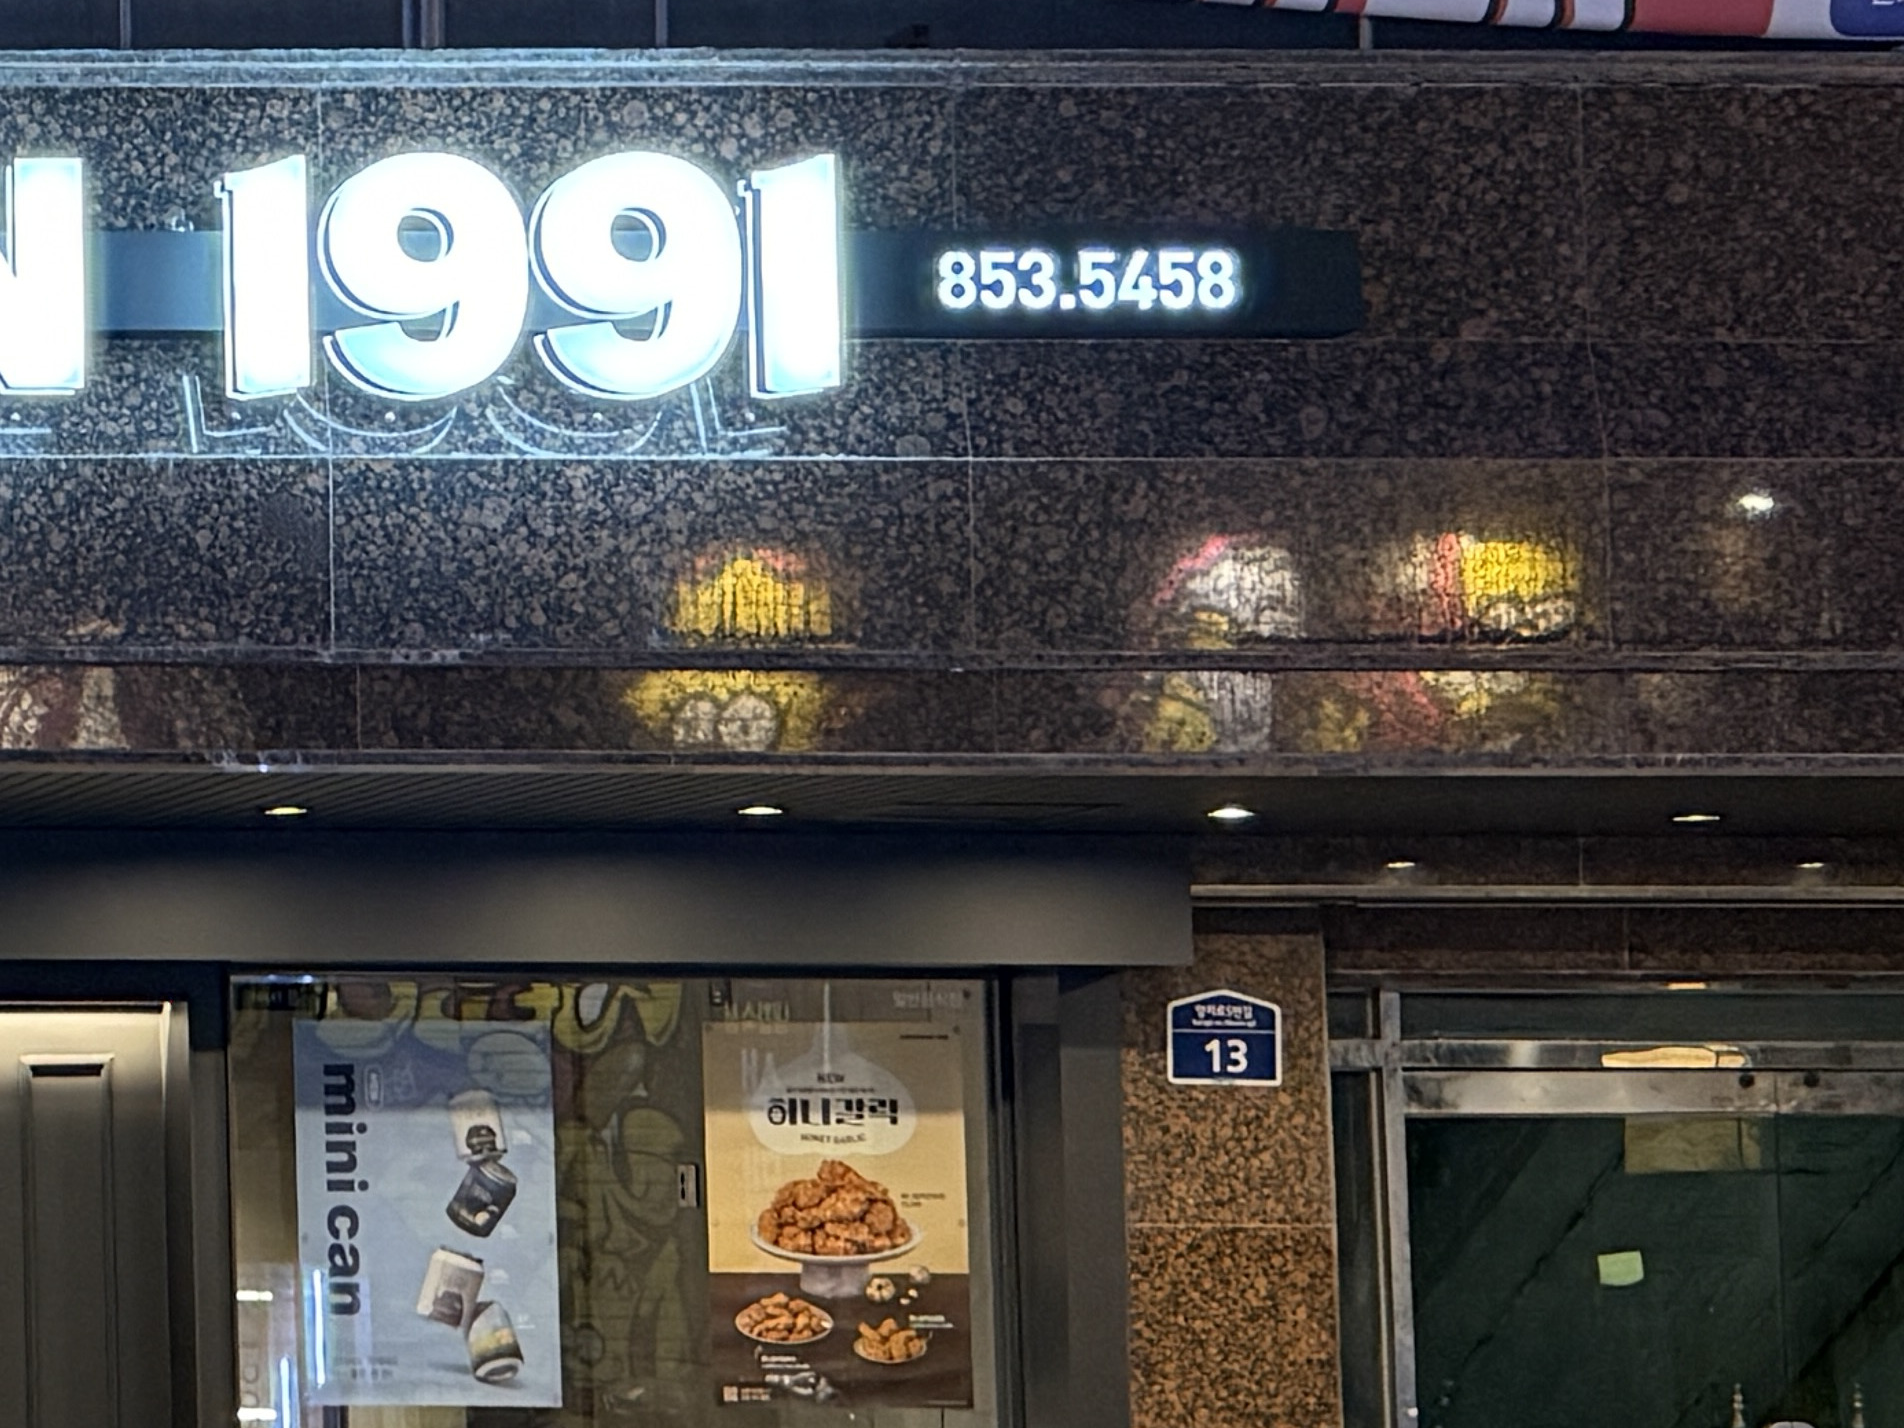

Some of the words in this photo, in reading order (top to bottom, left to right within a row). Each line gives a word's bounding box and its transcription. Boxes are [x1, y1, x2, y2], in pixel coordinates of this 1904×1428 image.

[214, 150, 842, 401] 1991
[936, 247, 1238, 311] 853.5458
[1204, 1038, 1248, 1073] 13
[322, 1062, 370, 1194] mini
[326, 1204, 363, 1317] can
